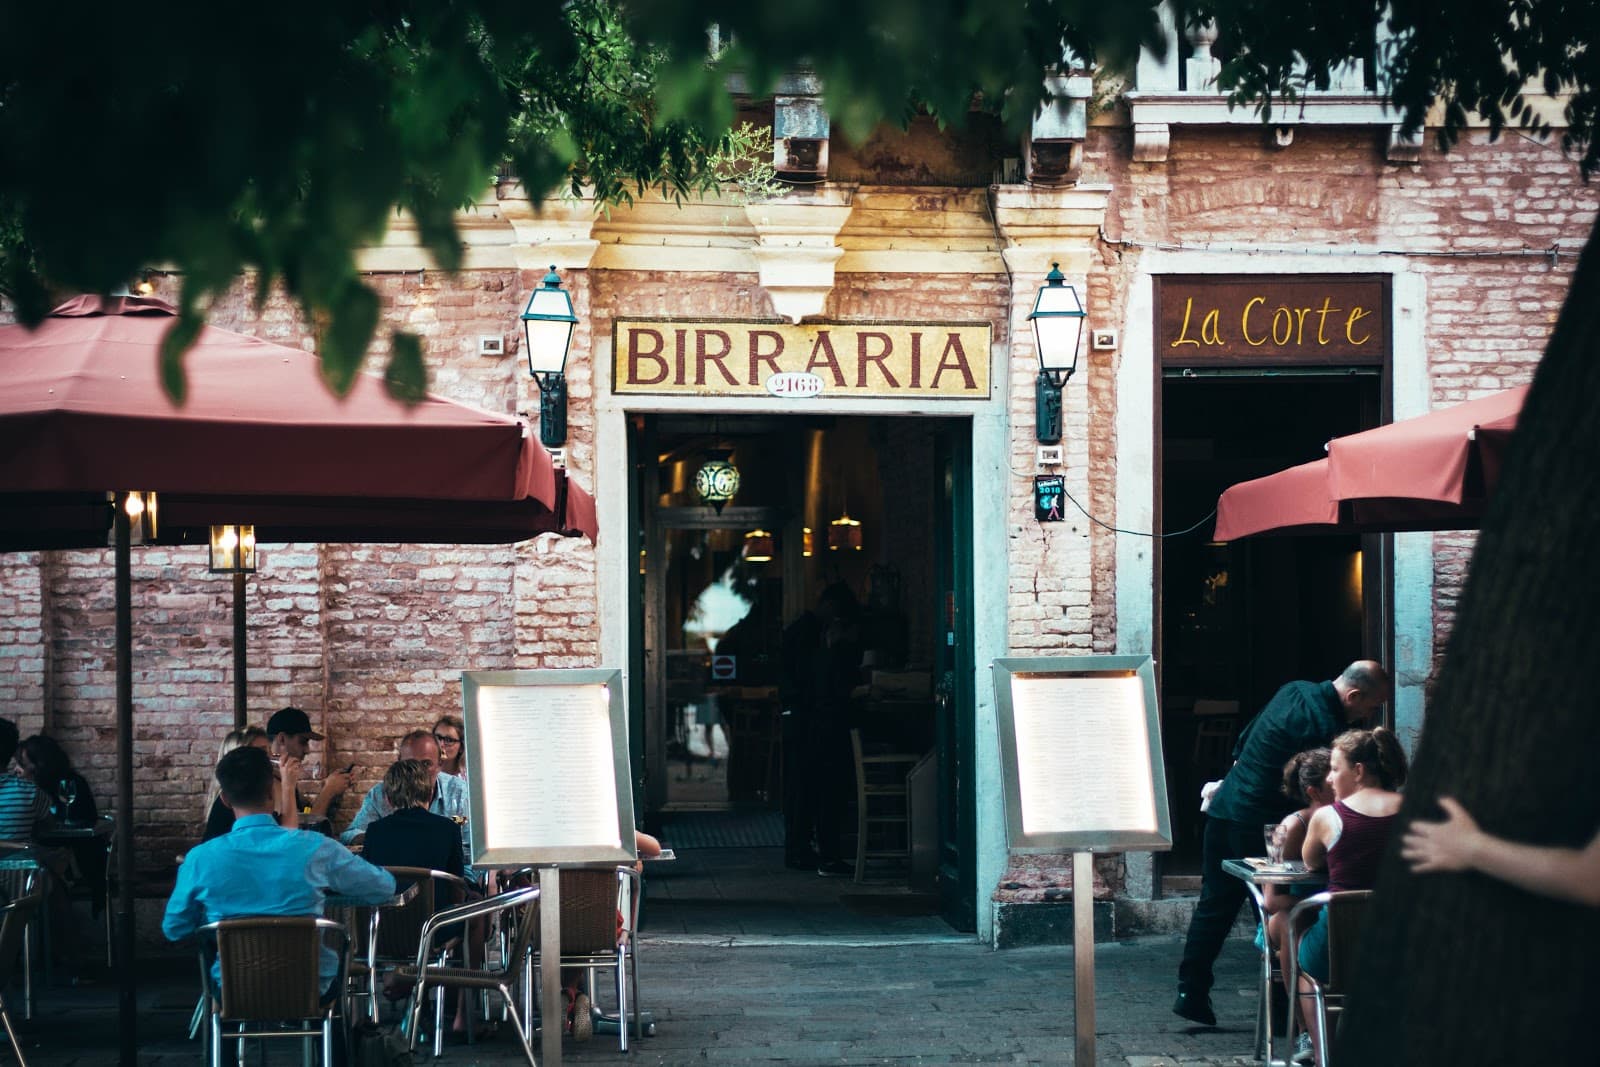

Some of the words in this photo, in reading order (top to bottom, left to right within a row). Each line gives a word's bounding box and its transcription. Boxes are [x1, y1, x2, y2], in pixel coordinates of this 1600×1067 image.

[1170, 296, 1226, 348] La
[1242, 295, 1373, 346] Corte
[626, 328, 979, 389] BIRRARIA
[774, 377, 818, 392] 2168
[1039, 486, 1061, 494] 2018
